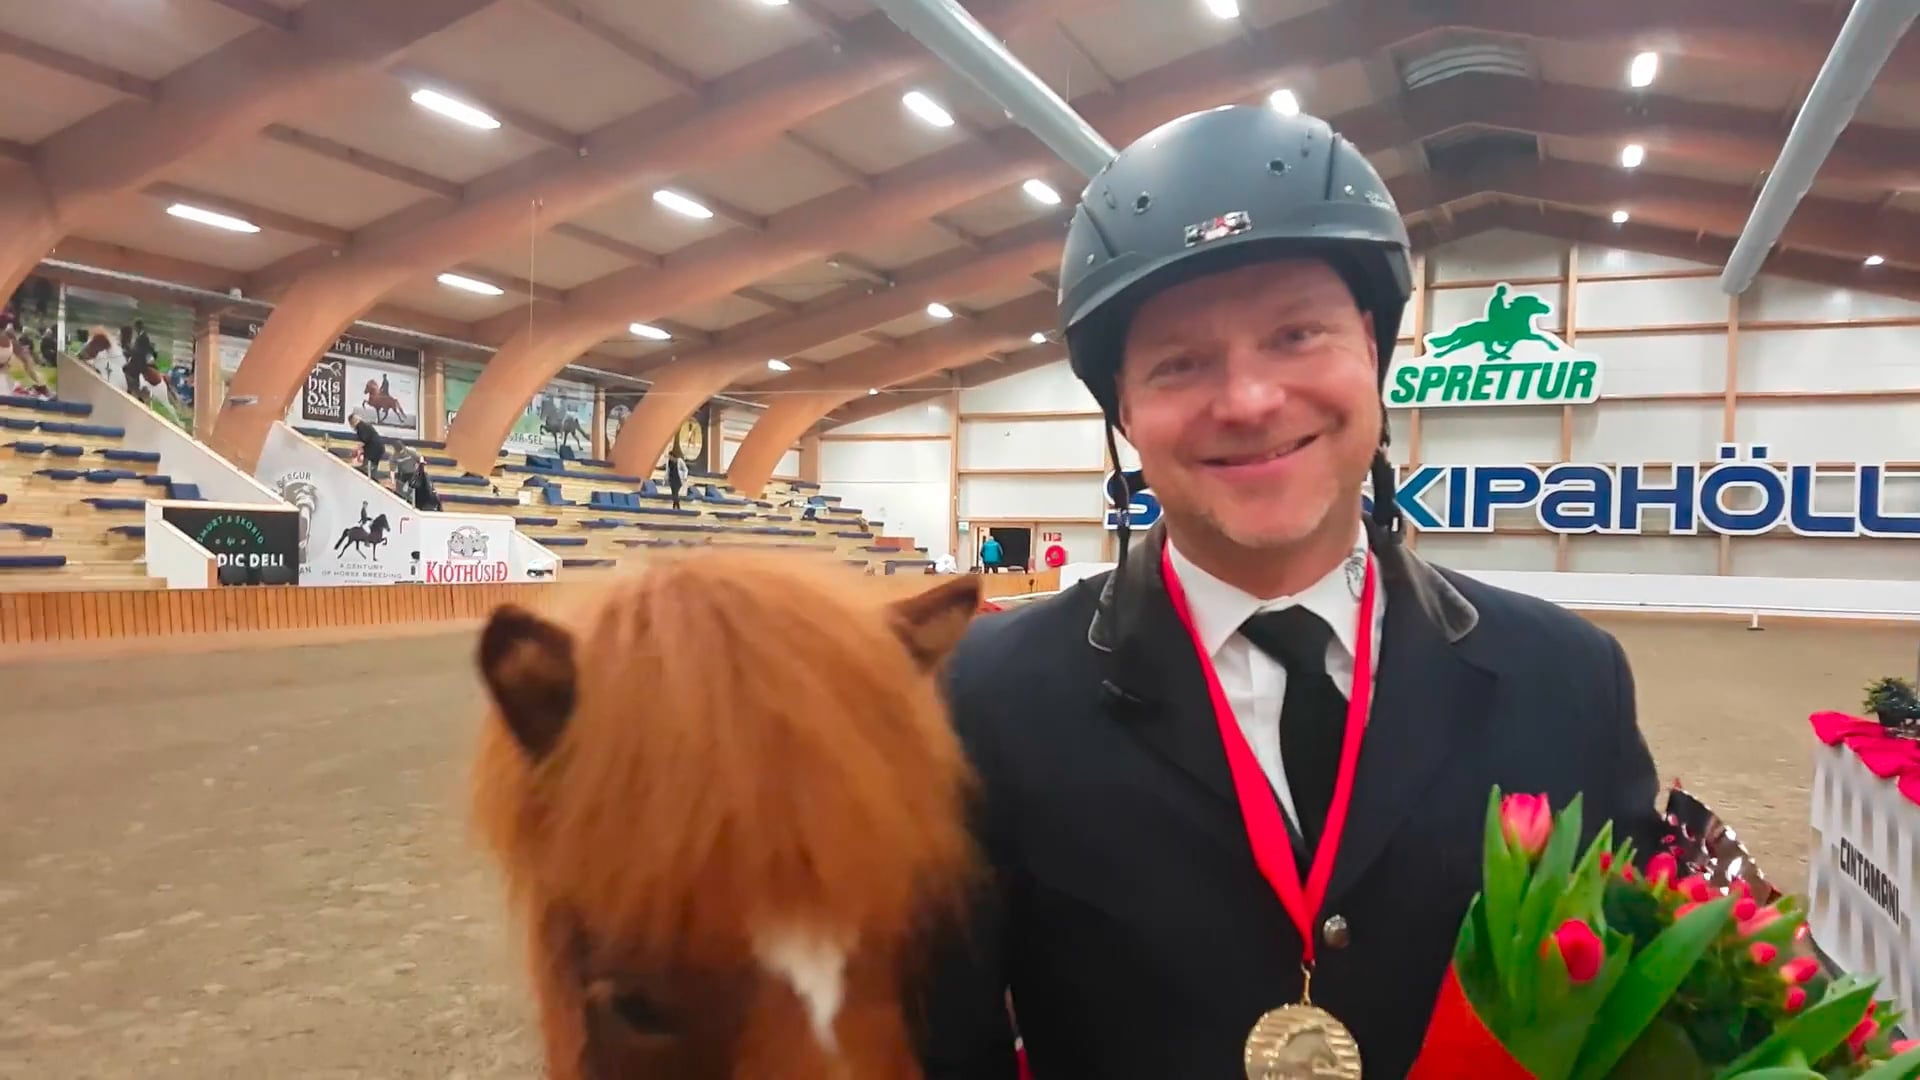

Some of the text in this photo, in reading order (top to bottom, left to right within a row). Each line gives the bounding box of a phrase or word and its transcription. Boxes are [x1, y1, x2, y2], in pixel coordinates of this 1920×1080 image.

[1390, 361, 1597, 404] SPRETTUR
[217, 553, 284, 568] DIC DELI
[1840, 836, 1899, 926] CINTAMANI
